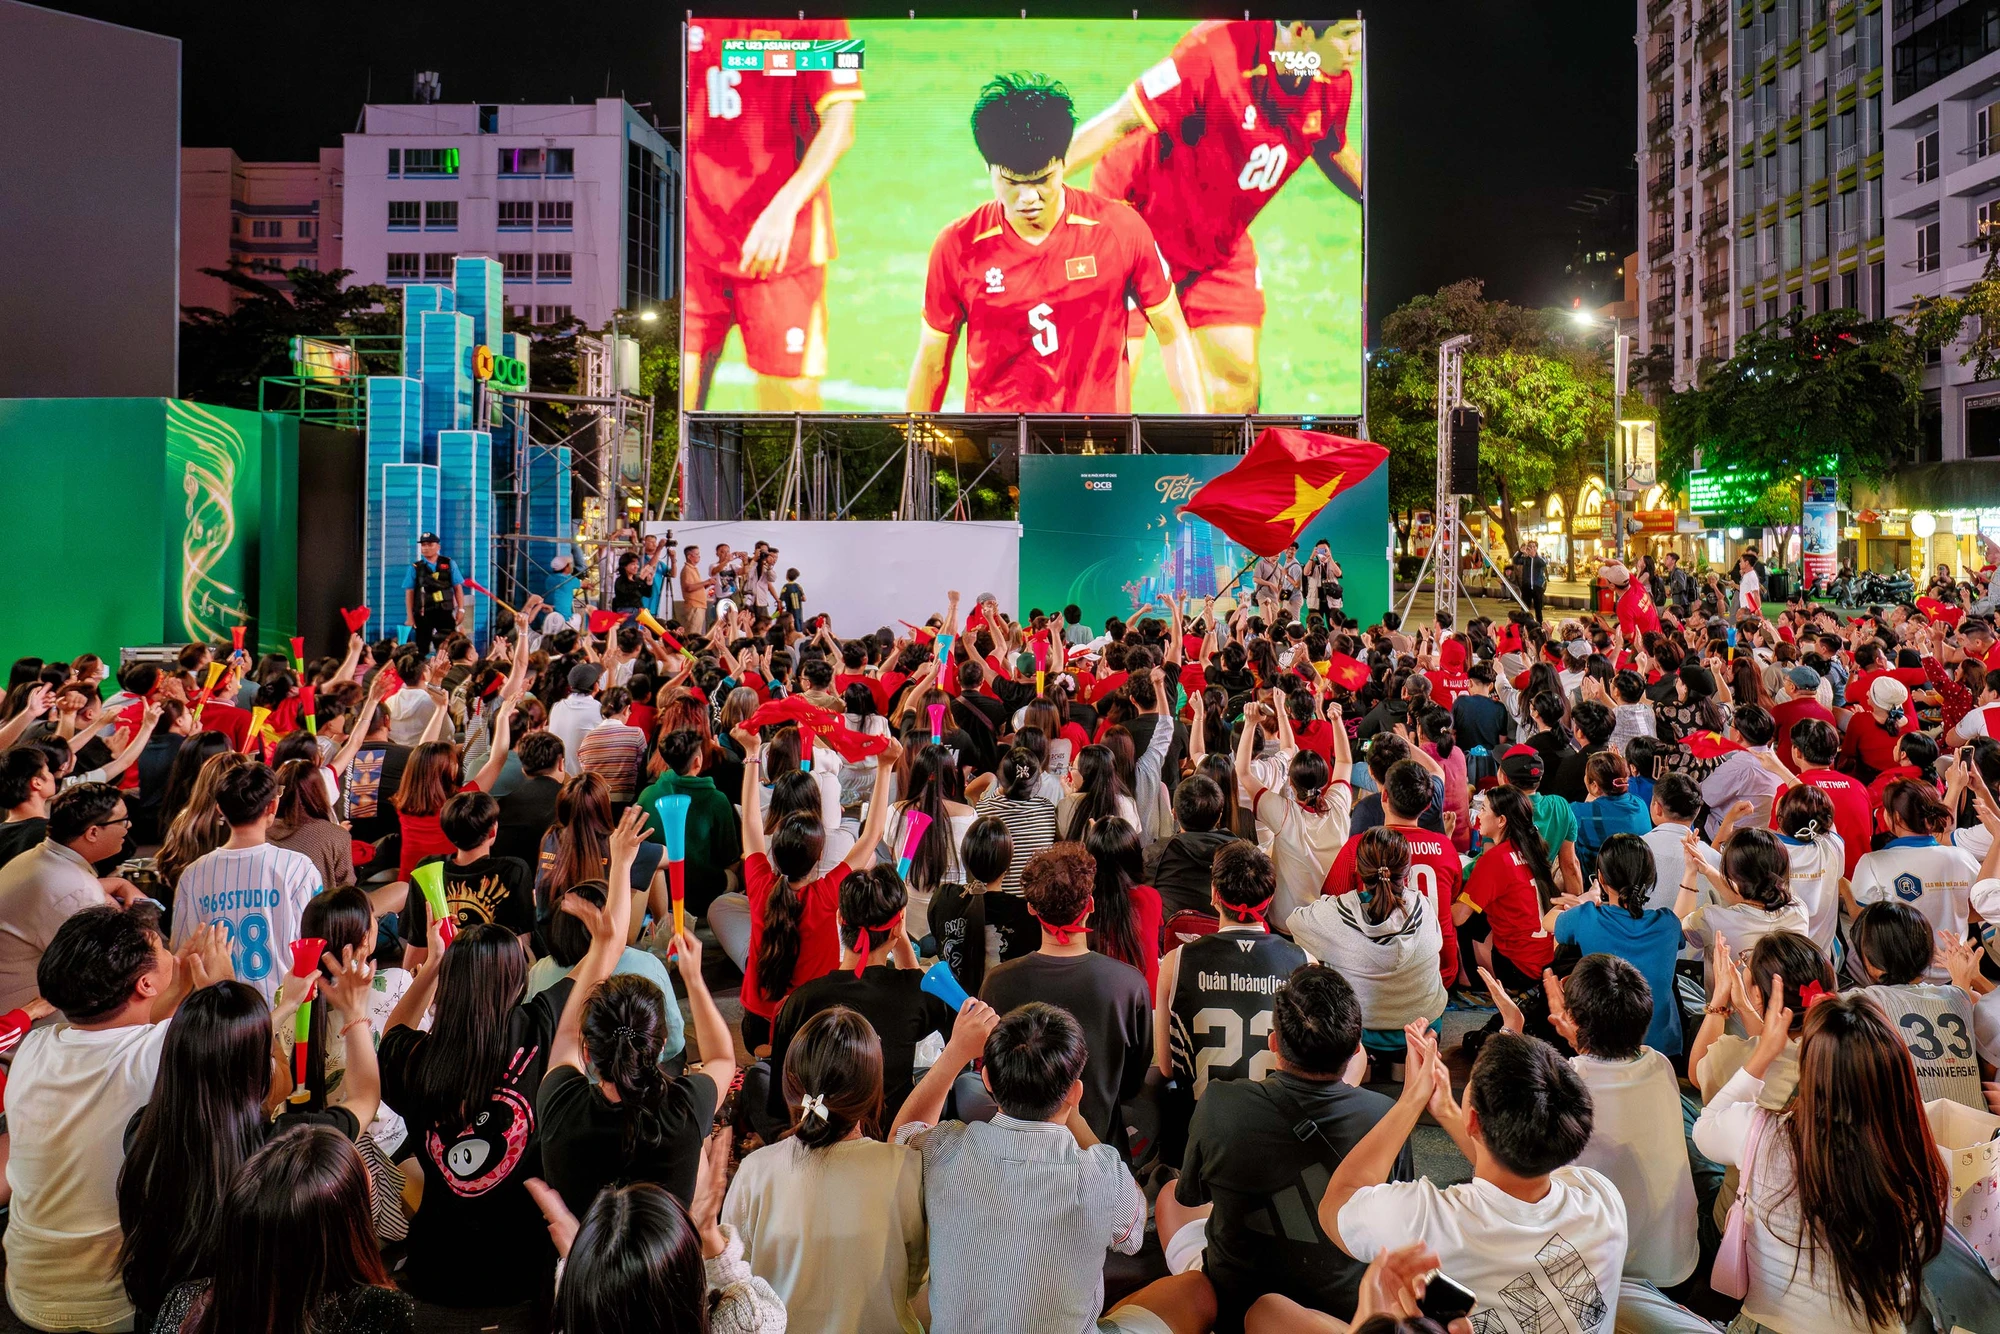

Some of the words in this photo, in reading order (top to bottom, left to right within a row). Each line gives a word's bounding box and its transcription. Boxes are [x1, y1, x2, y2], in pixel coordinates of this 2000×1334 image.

[725, 40, 744, 50] AFC
[745, 40, 763, 50] U23
[763, 40, 791, 50] ASIAN
[791, 41, 811, 51] CUP
[727, 56, 758, 67] 88:48
[772, 54, 788, 68] VIE
[801, 57, 809, 67] 2
[820, 57, 827, 67] 1
[837, 53, 859, 68] KOR
[1268, 51, 1321, 70] TV360
[706, 66, 742, 120] 16
[1238, 143, 1288, 193] 20
[1028, 302, 1059, 357] 5
[494, 355, 527, 387] OCB
[1093, 481, 1113, 489] OCB
[1155, 473, 1202, 503] Tết
[1816, 780, 1850, 789] VIETNAM
[1198, 971, 1228, 992] Quân
[1900, 1012, 1973, 1060] 33
